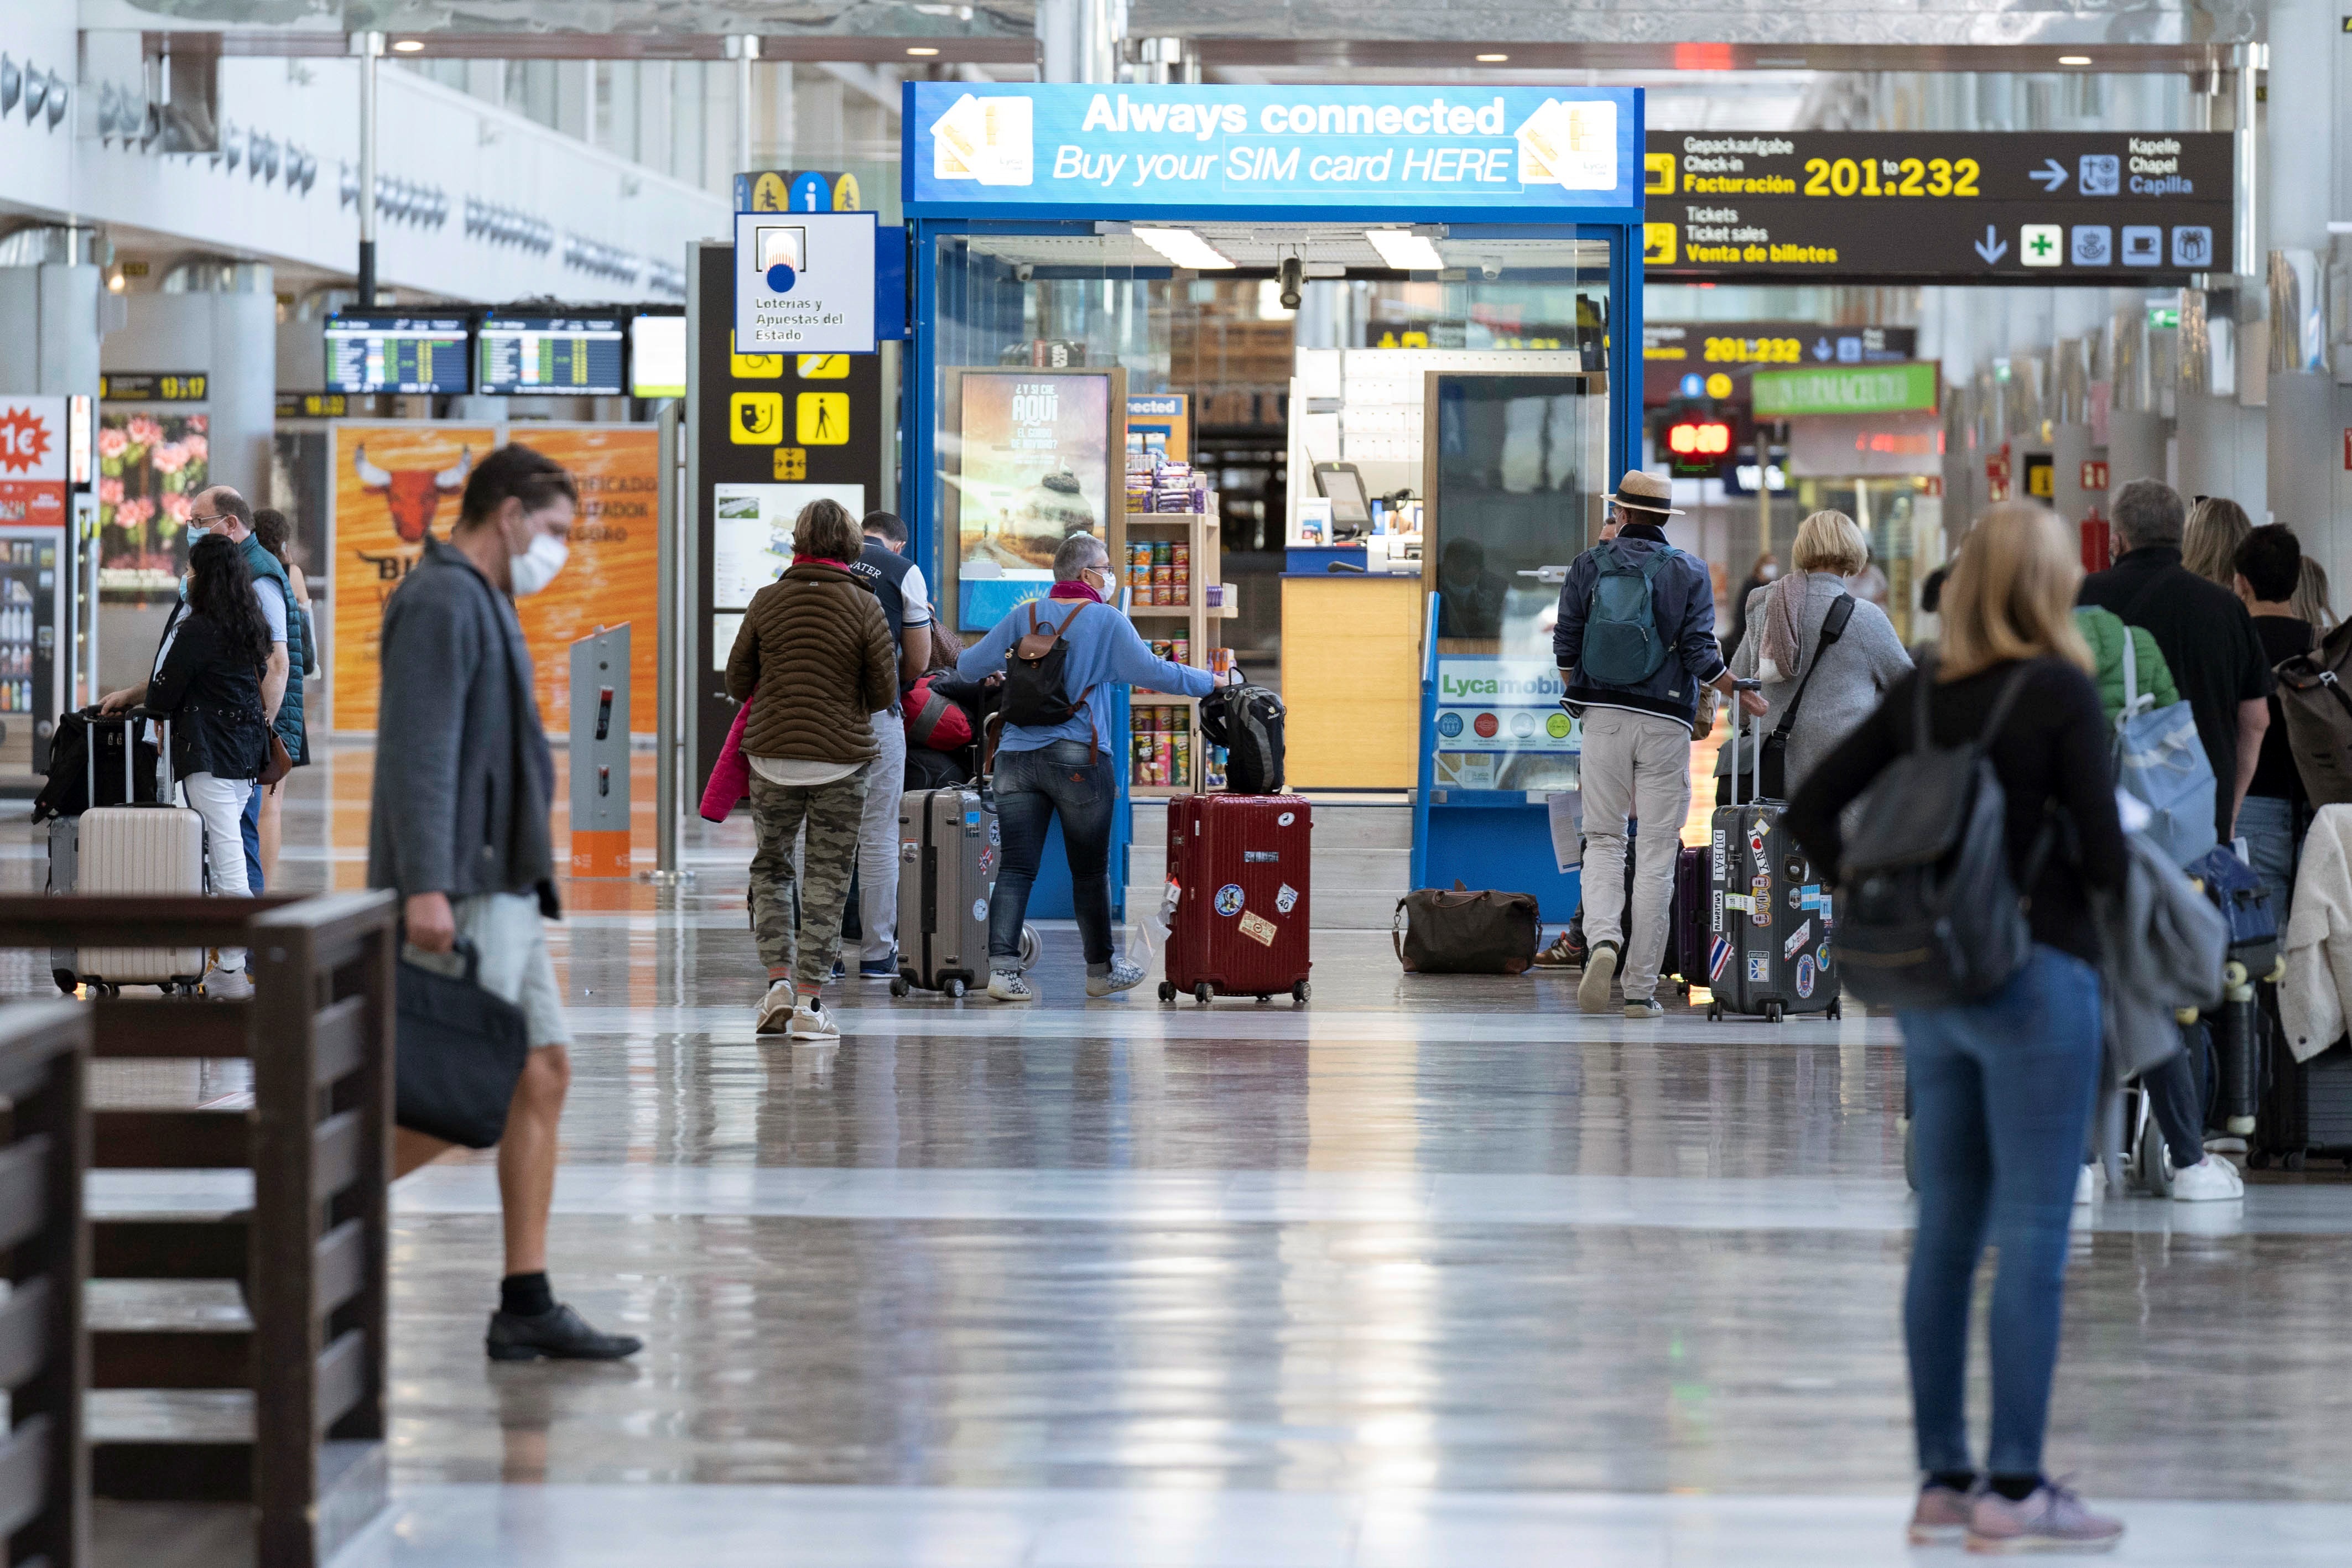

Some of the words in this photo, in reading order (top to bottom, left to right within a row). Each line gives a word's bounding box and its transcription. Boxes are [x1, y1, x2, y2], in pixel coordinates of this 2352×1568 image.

[1081, 93, 1247, 141] Always
[1260, 96, 1505, 134] connected
[2129, 137, 2182, 157] Kapelle
[1053, 145, 1127, 187] Buy
[1132, 153, 1219, 187] your
[1226, 146, 1300, 181] SIM
[1309, 148, 1393, 182] card
[1401, 148, 1513, 182] HERE
[1684, 155, 1745, 173] Check-in
[2129, 155, 2178, 175] Chapel
[1684, 173, 1796, 193] Facturación
[1804, 158, 1882, 196] 201
[1882, 159, 1900, 176] to
[1898, 158, 1980, 197] 232
[2129, 174, 2194, 197] Capilla
[1884, 180, 1897, 196] a
[1685, 205, 1739, 223] Tickets
[1685, 225, 1730, 242] Ticket
[1731, 225, 1770, 242] sales
[1685, 243, 1741, 263] Venta
[1742, 243, 1768, 263] de
[1770, 243, 1838, 263] billetes
[756, 297, 811, 309] Loterías
[815, 300, 823, 311] y
[756, 314, 819, 327] Apuestas
[823, 312, 844, 324] del
[756, 329, 802, 340] Estado
[1012, 394, 1059, 426] AQUÍ
[1, 422, 36, 456] 1€
[1443, 674, 1567, 697] Lycamobil
[1715, 831, 1724, 877] DUBAI
[1755, 850, 1770, 872] NY
[1278, 899, 1289, 910] 40
